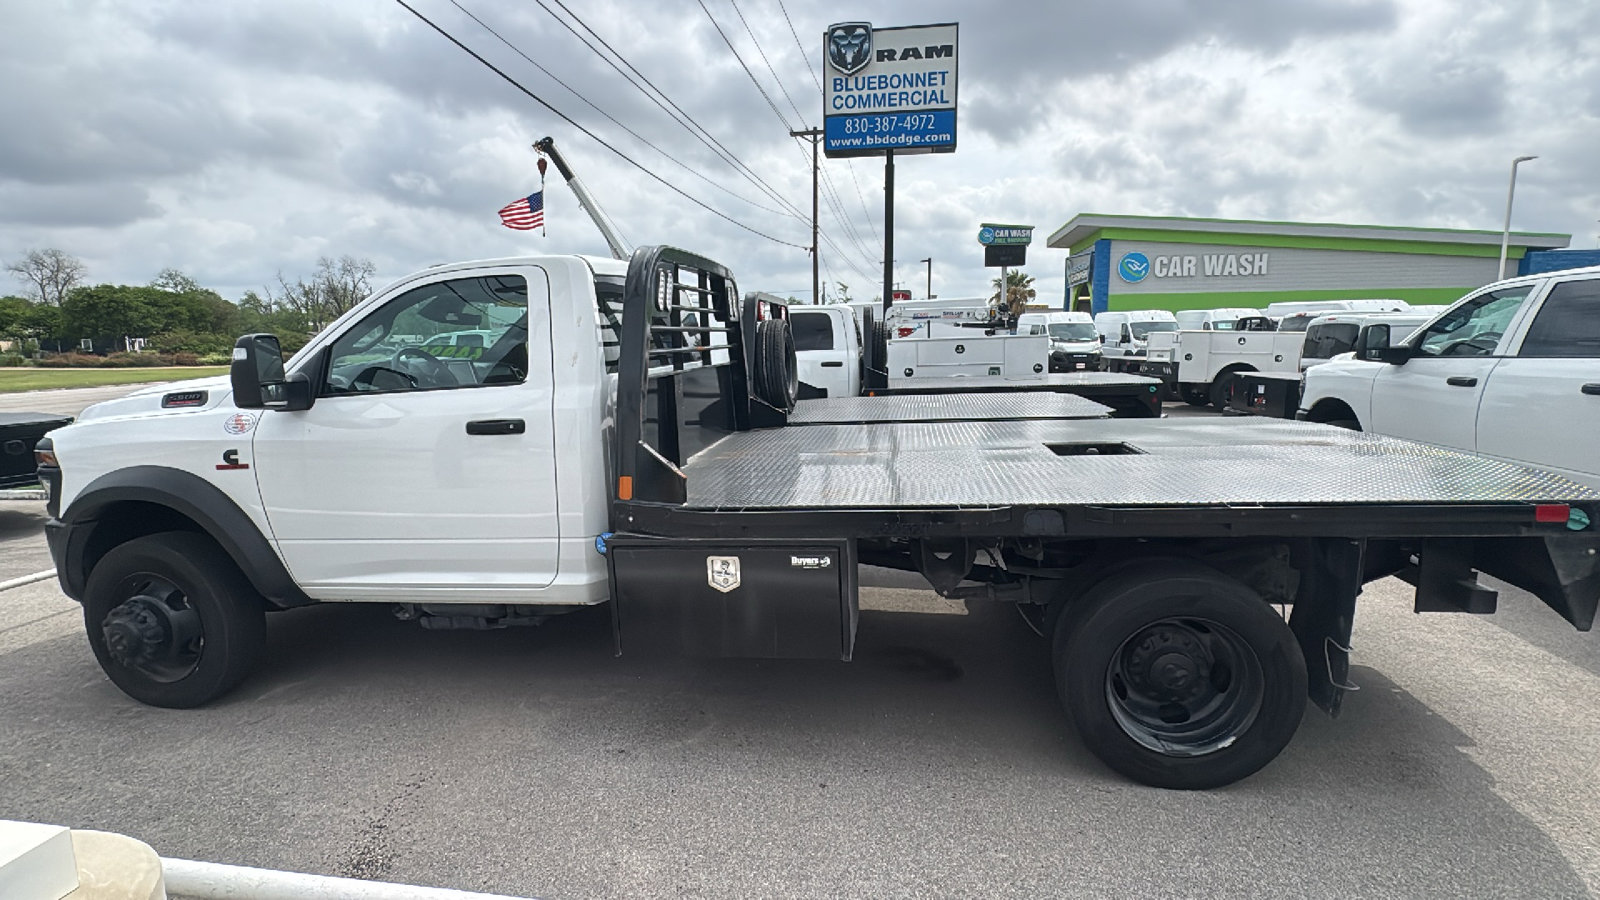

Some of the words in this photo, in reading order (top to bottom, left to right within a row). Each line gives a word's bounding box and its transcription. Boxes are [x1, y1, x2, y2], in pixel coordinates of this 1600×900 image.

[876, 44, 953, 62] RAM
[832, 71, 949, 92] BLUEBONNET
[832, 89, 949, 110] COMMERCIAL
[845, 114, 935, 134] 830-387-4972
[830, 133, 951, 147] www.bbdodge.com
[994, 229, 1009, 238] CAR
[1010, 229, 1030, 238] WASH
[1154, 255, 1197, 278] CAR
[1203, 253, 1268, 276] WASH
